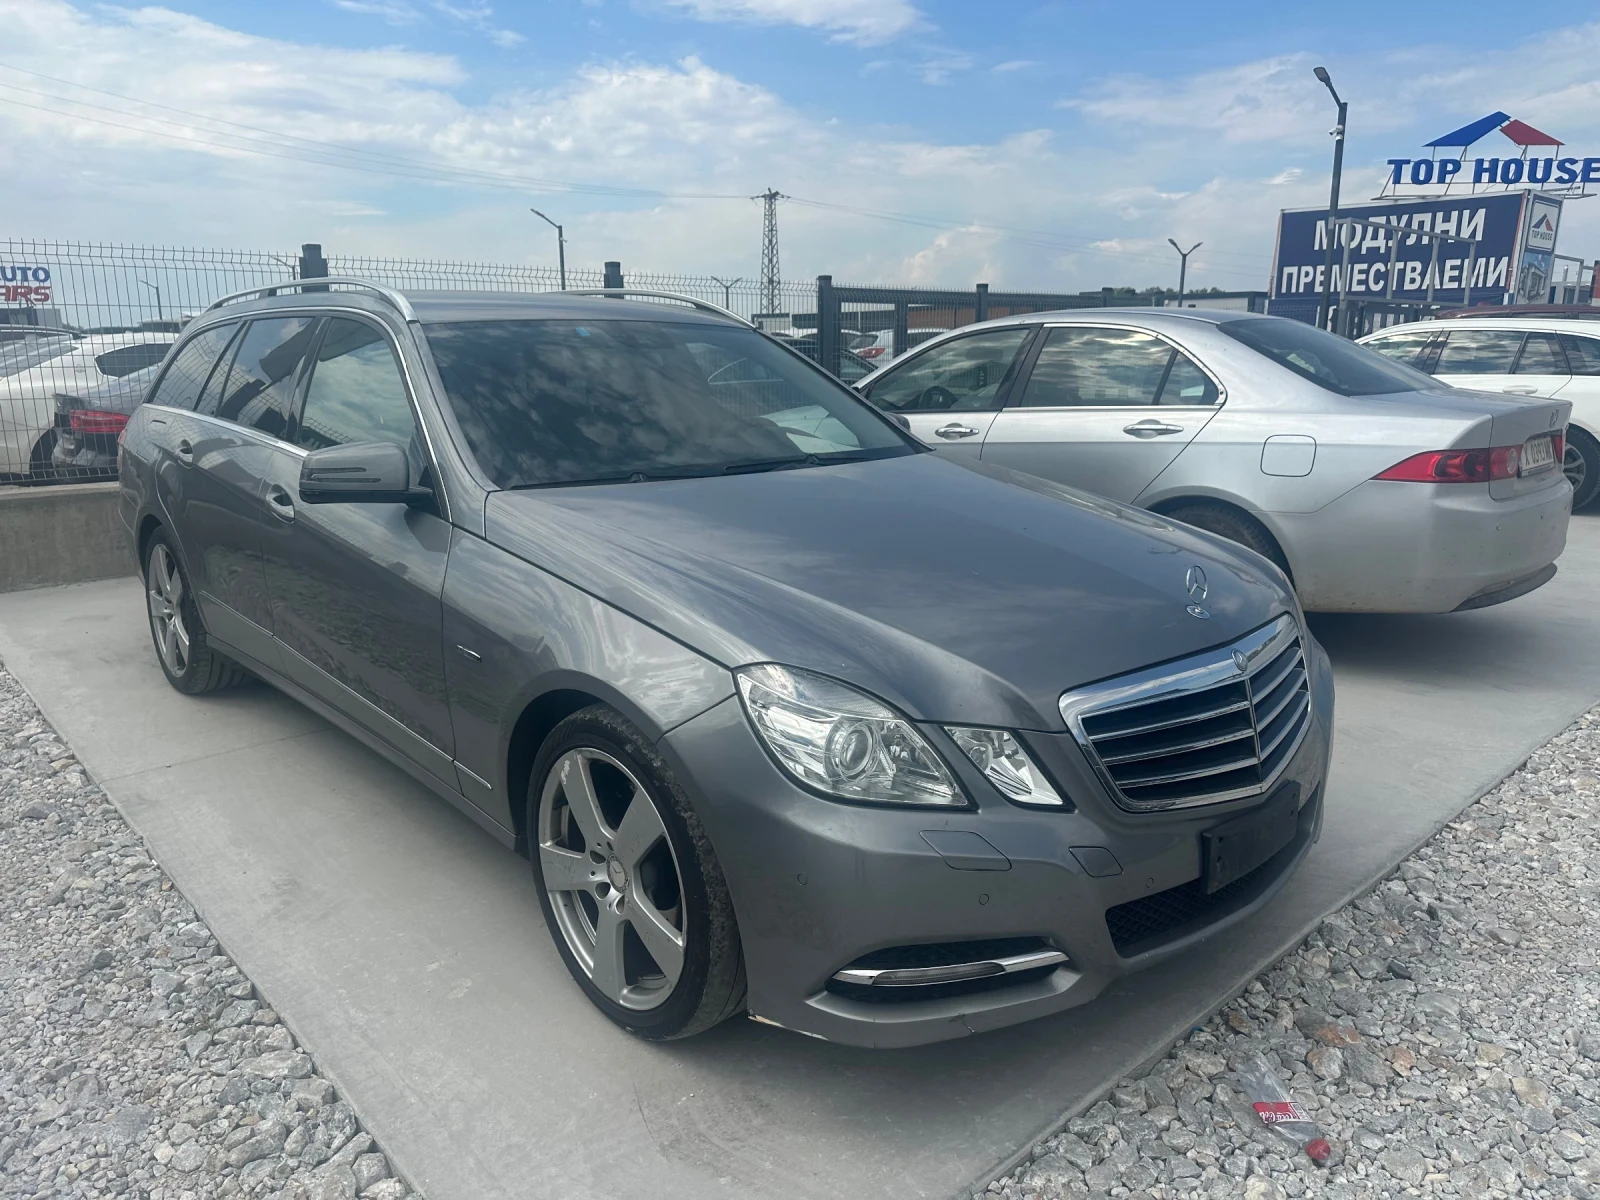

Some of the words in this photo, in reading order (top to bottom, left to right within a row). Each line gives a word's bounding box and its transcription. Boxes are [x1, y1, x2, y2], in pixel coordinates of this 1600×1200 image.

[1387, 158, 1462, 185] TOP
[1473, 157, 1600, 185] HOUSE
[1313, 208, 1486, 255] МОДУЛНИ
[0, 266, 51, 282] UTO
[1281, 256, 1509, 294] ПРЕМЕСТВАЕМИ
